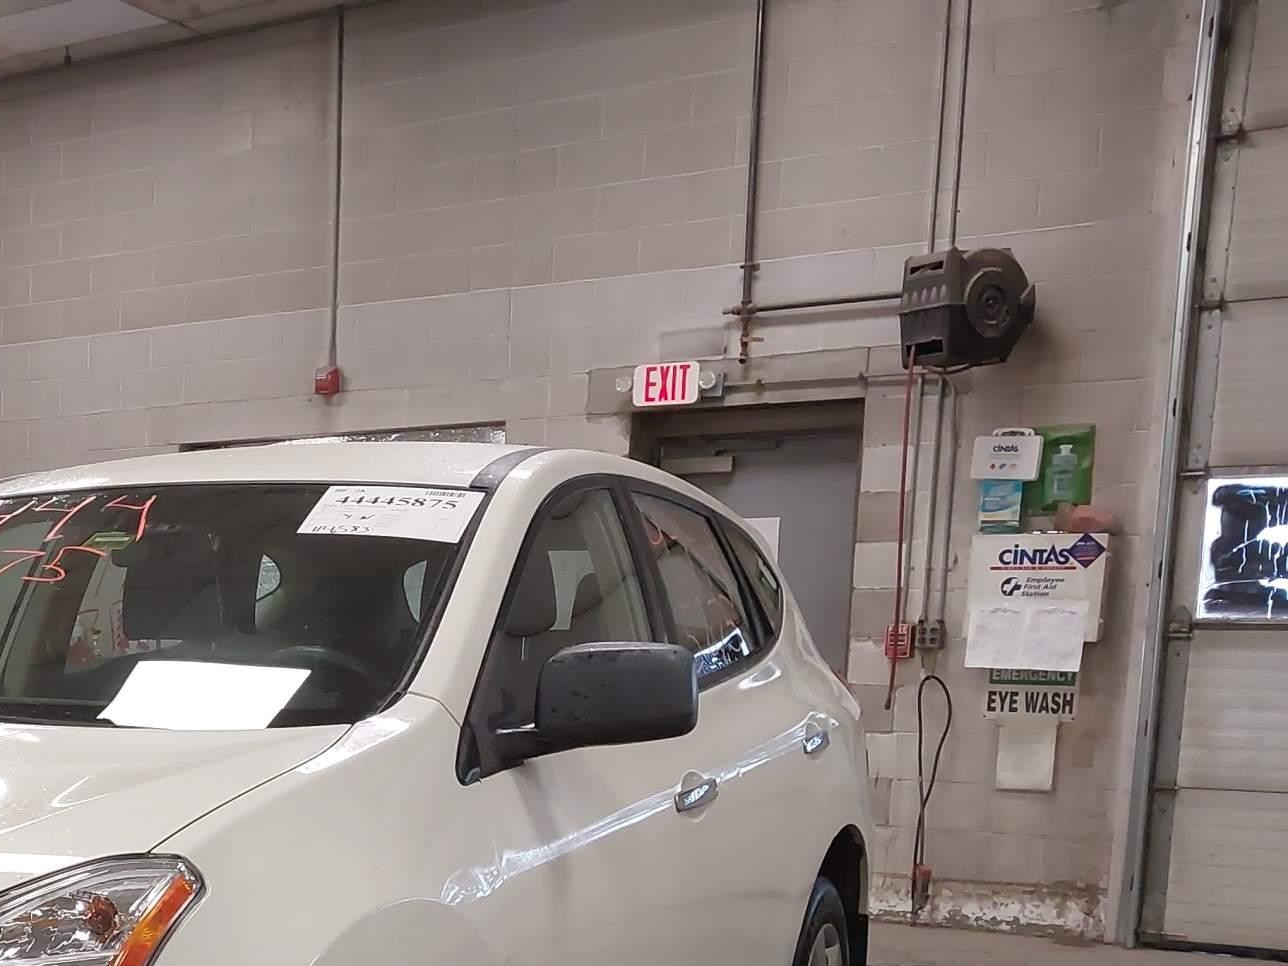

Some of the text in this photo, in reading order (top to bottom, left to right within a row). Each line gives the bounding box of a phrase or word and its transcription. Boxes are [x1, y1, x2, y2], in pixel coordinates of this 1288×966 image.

[644, 364, 691, 402] EXIT
[335, 494, 460, 510] 44445875
[998, 544, 1071, 566] CINTAS
[1026, 576, 1065, 584] Employee
[992, 669, 1073, 682] EMERGENCY
[987, 691, 1074, 714] EYE WASH
